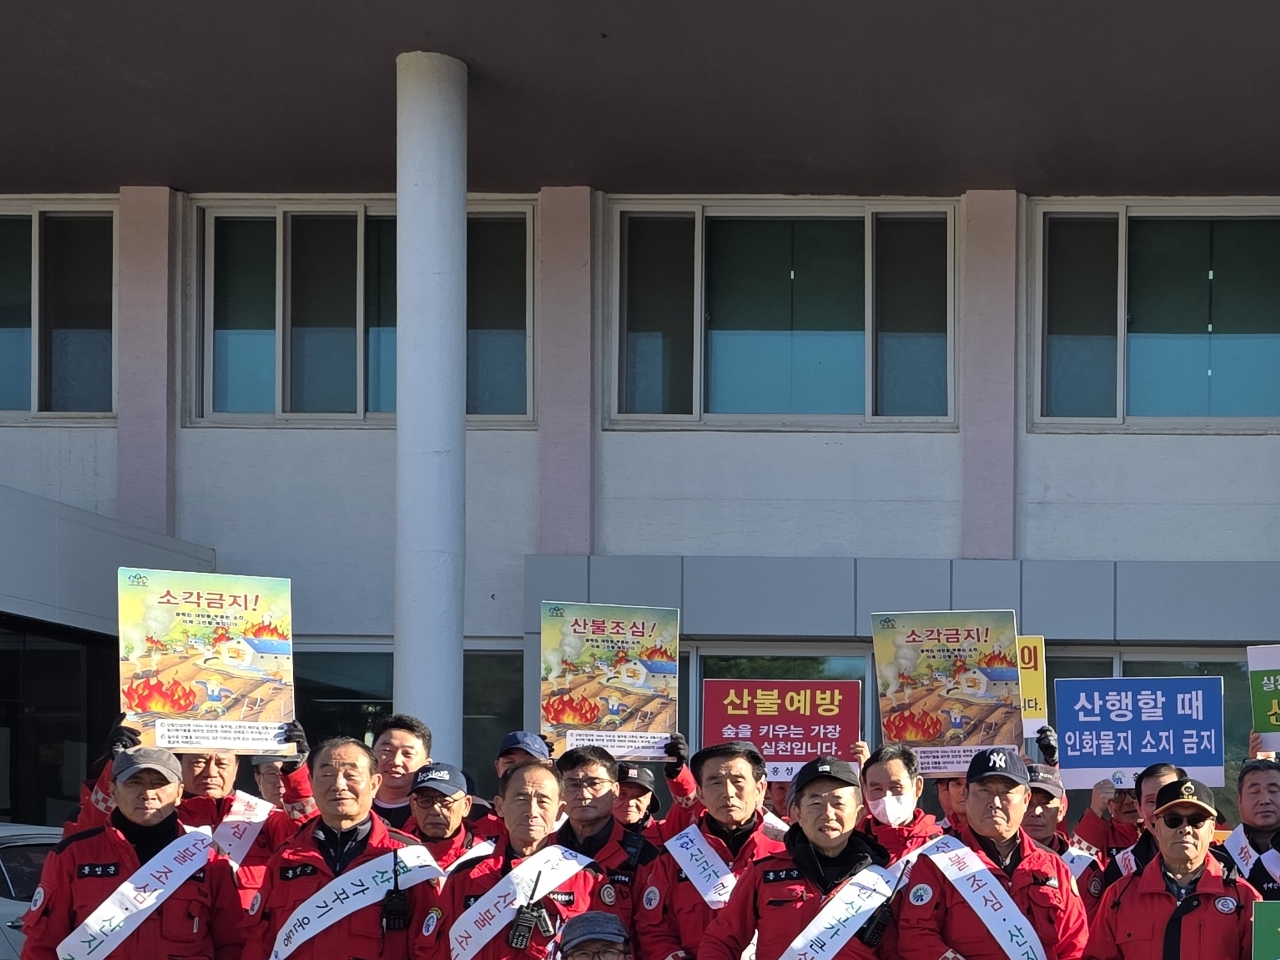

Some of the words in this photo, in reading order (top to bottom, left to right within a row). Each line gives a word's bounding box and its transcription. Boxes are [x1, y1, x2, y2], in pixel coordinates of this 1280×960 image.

[157, 589, 260, 612] 소각금지!
[571, 618, 657, 638] 산불조심!
[905, 627, 990, 644] 소각금지!
[723, 688, 843, 716] 산불예방
[1074, 690, 1166, 722] 산행할
[1177, 690, 1204, 721] 때
[721, 724, 752, 738] 숲을
[758, 724, 804, 738] 키우는
[810, 724, 841, 738] 가장
[1064, 730, 1132, 756] 인화물지
[1140, 729, 1174, 755] 소지
[1182, 728, 1215, 754] 금지
[760, 741, 842, 756] 실천입니다.
[988, 752, 1007, 768] NY
[133, 837, 213, 905] 산불조심
[935, 840, 1004, 912] 산불조심
